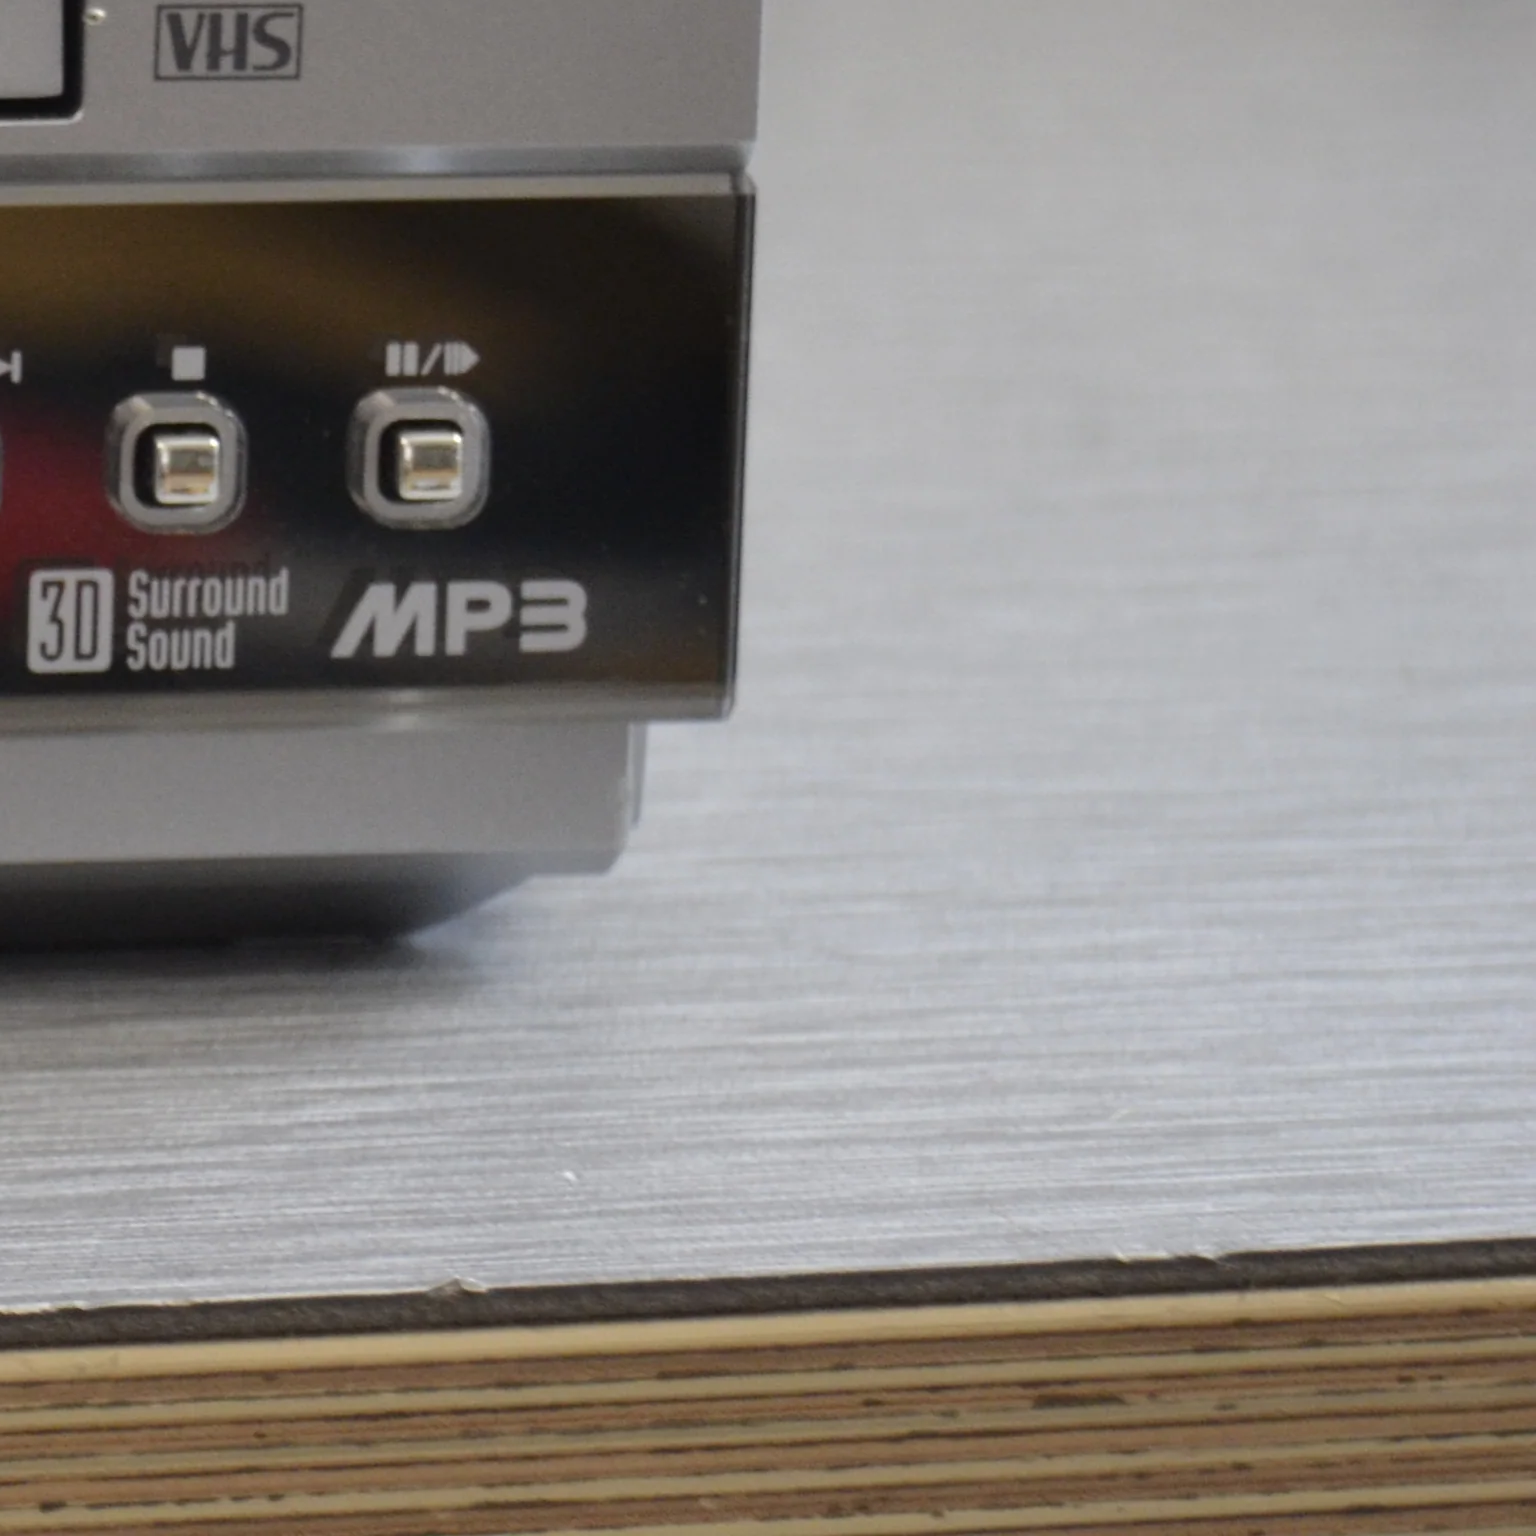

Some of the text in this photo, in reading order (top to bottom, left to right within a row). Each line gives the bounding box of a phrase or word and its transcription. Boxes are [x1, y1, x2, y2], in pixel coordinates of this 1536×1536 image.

[166, 11, 295, 72] VHS
[128, 567, 289, 618] Surround
[330, 579, 588, 659] MP3
[128, 621, 235, 670] Sound
